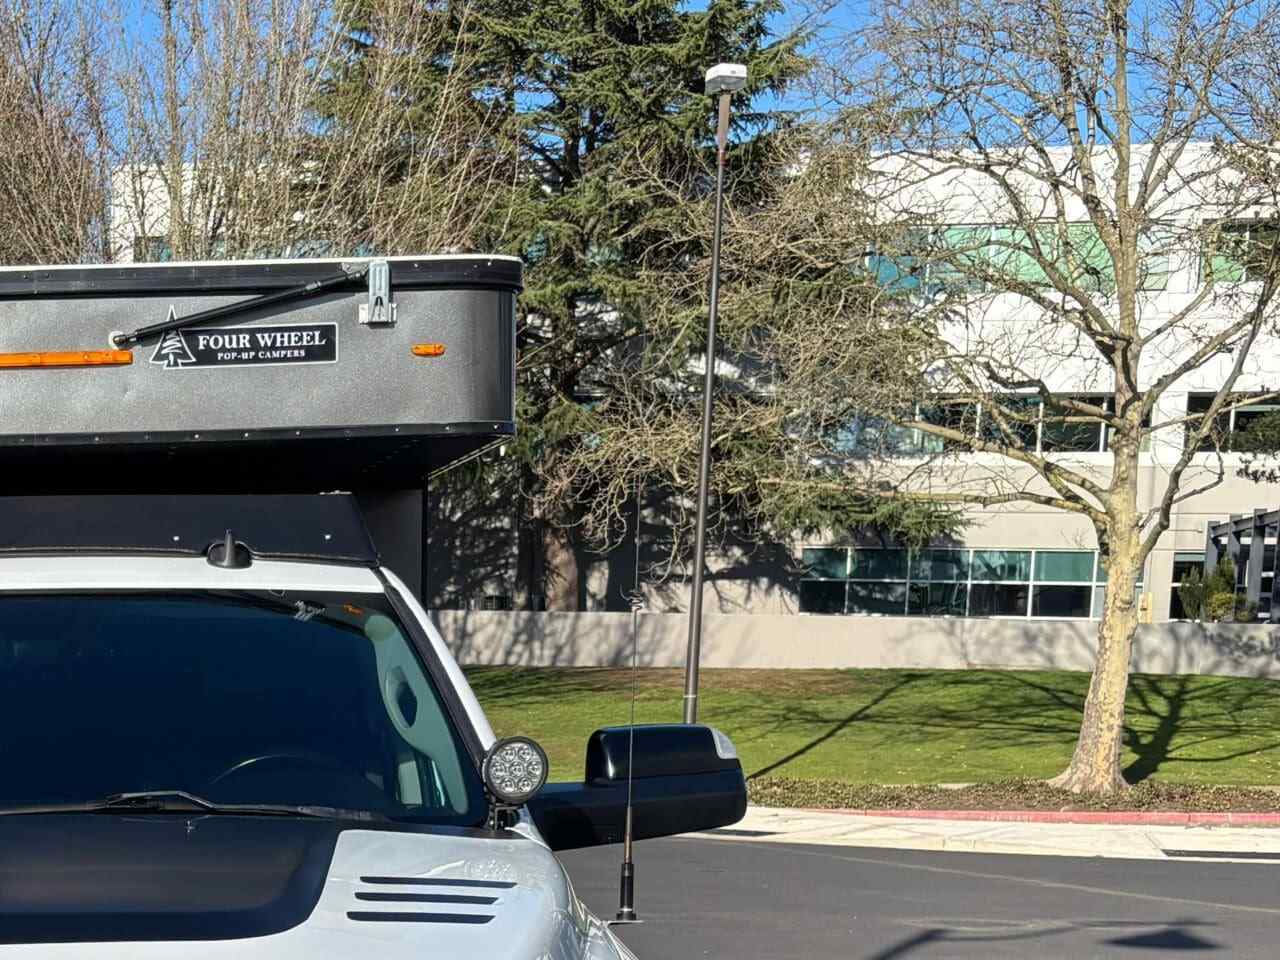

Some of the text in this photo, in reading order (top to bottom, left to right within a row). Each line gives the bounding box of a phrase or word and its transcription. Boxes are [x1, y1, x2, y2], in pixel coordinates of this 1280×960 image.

[197, 330, 327, 350] FOUR WHEEL
[217, 349, 306, 361] POP-UP CAMPERS
